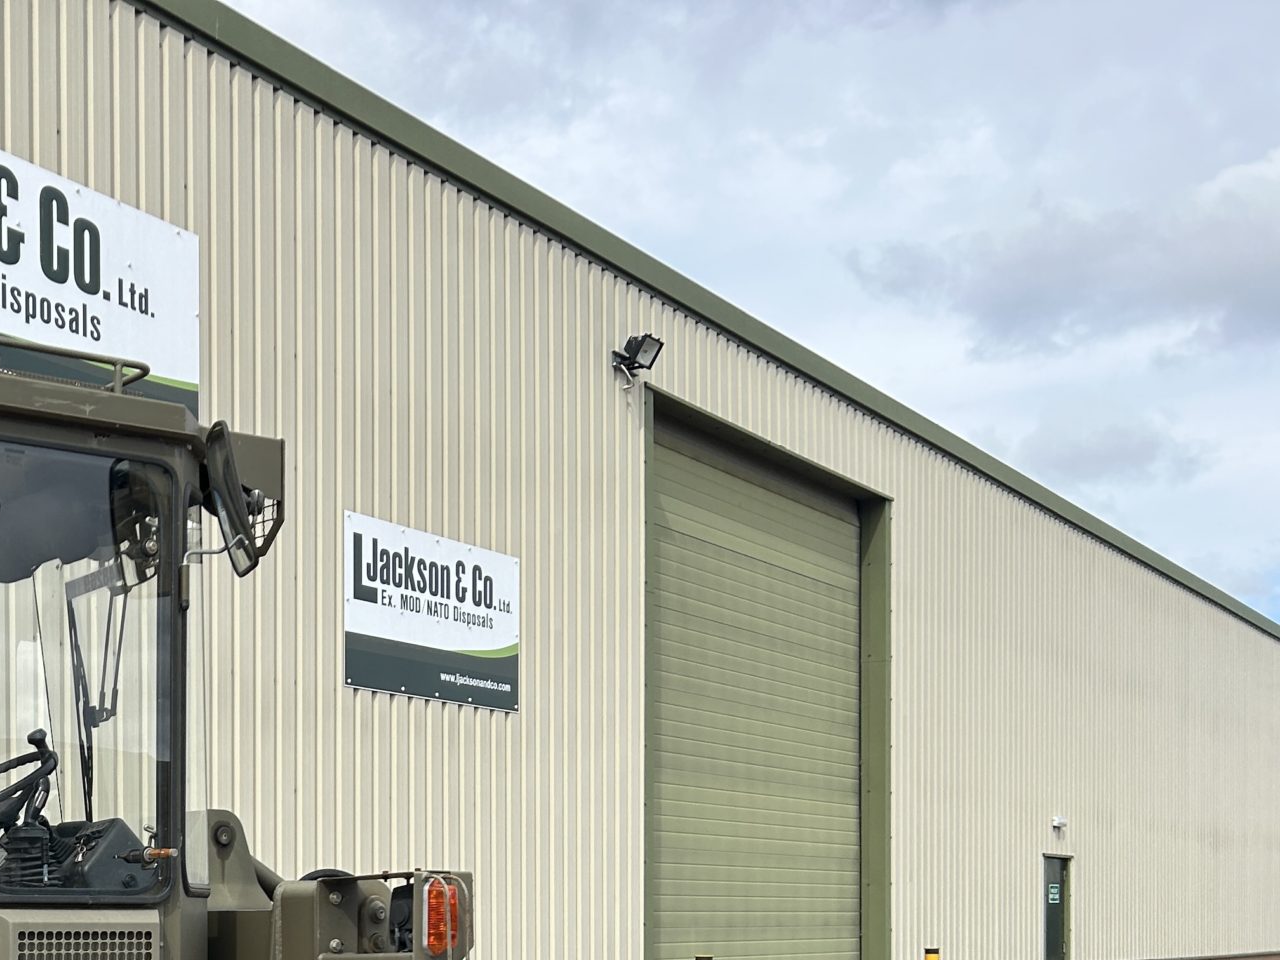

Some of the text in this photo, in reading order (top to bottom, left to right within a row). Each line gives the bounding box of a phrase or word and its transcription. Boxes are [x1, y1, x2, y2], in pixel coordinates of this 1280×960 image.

[40, 187, 111, 302] Co.
[119, 278, 156, 318] Ltd.
[381, 590, 494, 630] Ex. MOD/NATO Disposals
[455, 560, 468, 603] &
[472, 564, 497, 611] Co.
[498, 599, 513, 615] Ltd.
[440, 672, 511, 692] www.ljacksonandco.com
